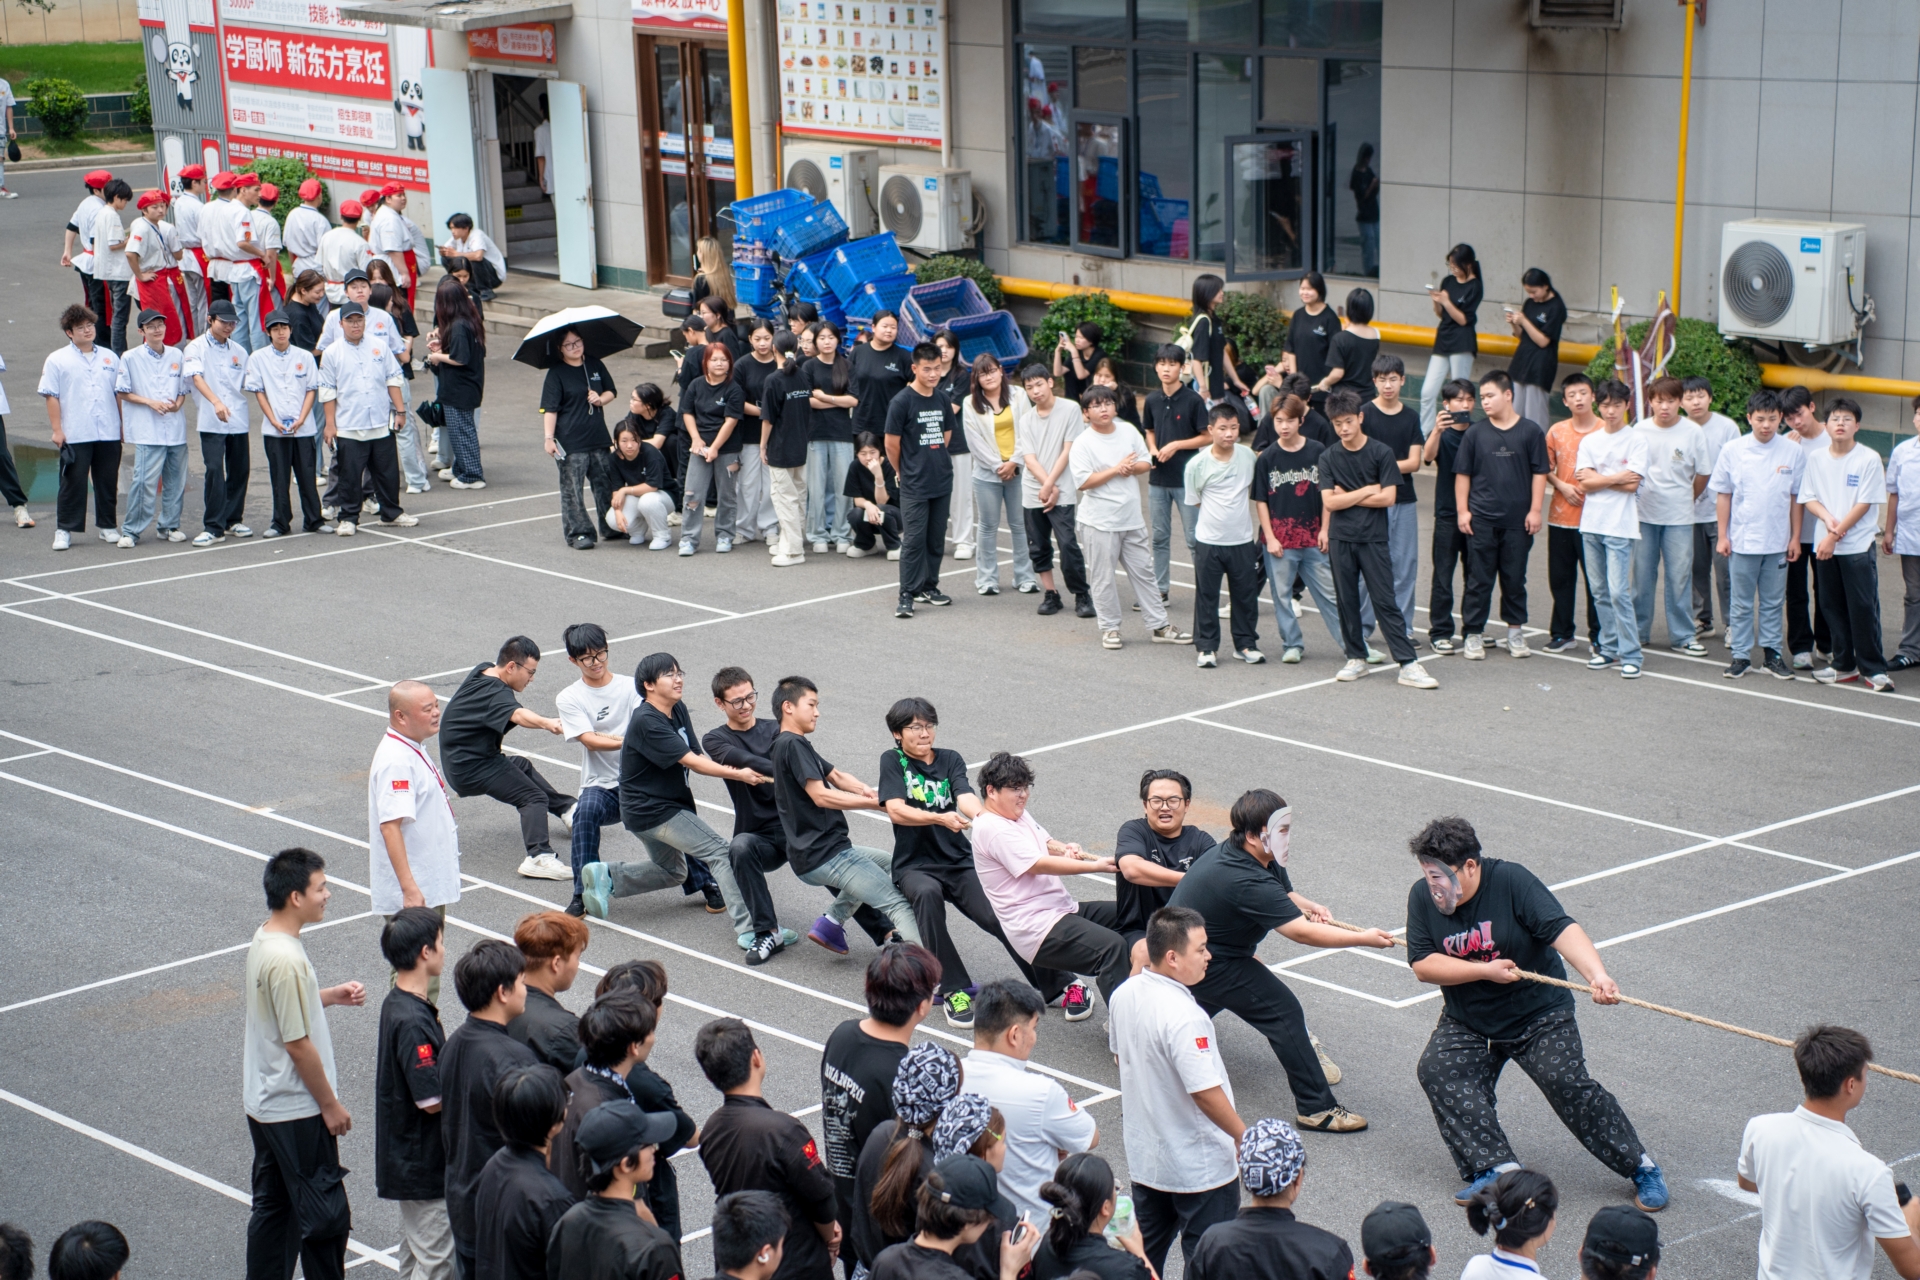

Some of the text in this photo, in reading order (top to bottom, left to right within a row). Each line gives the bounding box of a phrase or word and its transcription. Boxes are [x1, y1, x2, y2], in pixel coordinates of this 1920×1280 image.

[226, 33, 386, 85] 学厨师 新东方烹饪
[228, 142, 240, 151] NEW
[241, 143, 253, 153] EAST
[255, 145, 267, 155] NEW
[283, 149, 295, 159] NEW
[310, 153, 323, 163] NEW
[341, 158, 354, 167] EAST
[357, 160, 369, 169] NEW
[370, 161, 383, 171] EAST
[385, 163, 398, 173] NEW
[399, 165, 412, 175] EAST
[414, 167, 427, 177] NEW
